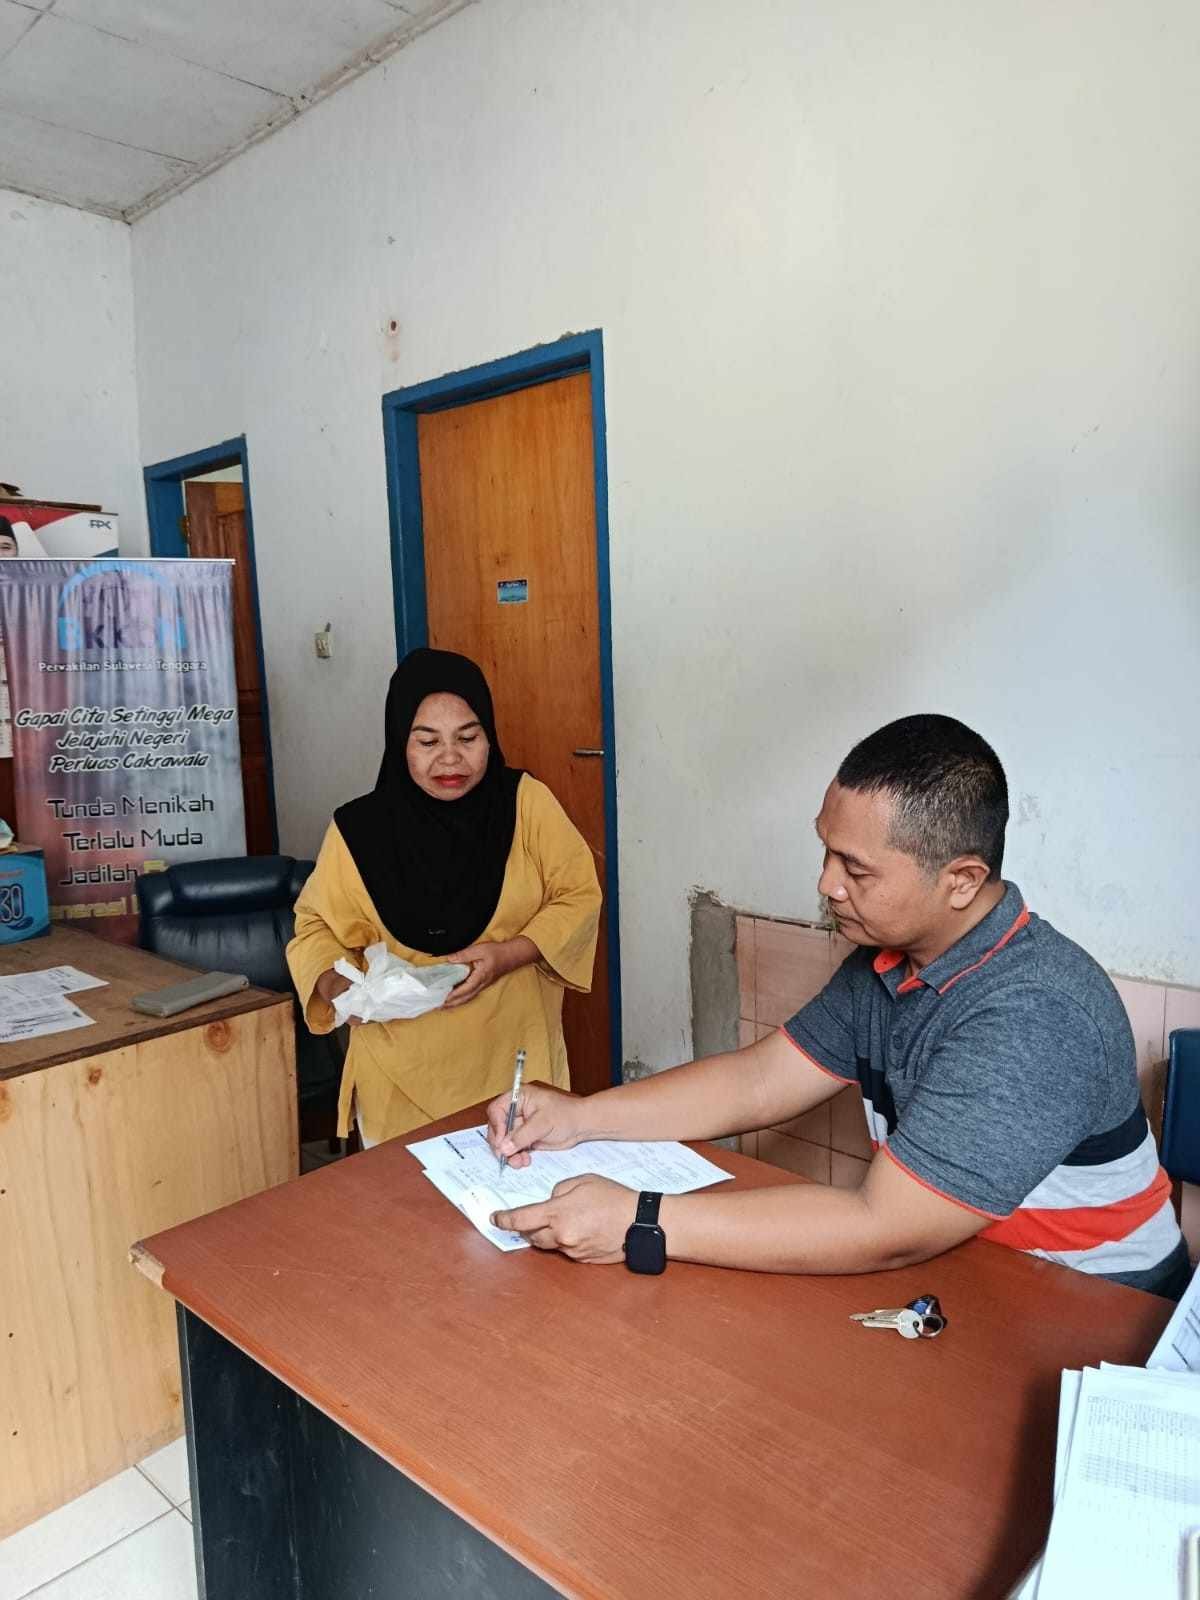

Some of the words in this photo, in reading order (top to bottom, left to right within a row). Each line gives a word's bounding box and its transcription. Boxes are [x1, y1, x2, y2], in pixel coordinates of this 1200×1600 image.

[16, 709, 67, 729] Gapai
[70, 707, 105, 724] Cita
[110, 707, 185, 727] Setinggi
[187, 705, 234, 725] Mega
[57, 731, 127, 750] Jelajahi
[129, 729, 189, 749] Negeri
[50, 755, 118, 772] Perluas
[122, 752, 209, 769] Cakrawala
[47, 799, 115, 818] Tunda
[122, 794, 214, 815] Menikah
[62, 831, 135, 851] Terlalu
[141, 828, 204, 847] Muda
[60, 864, 139, 886] Jadilah
